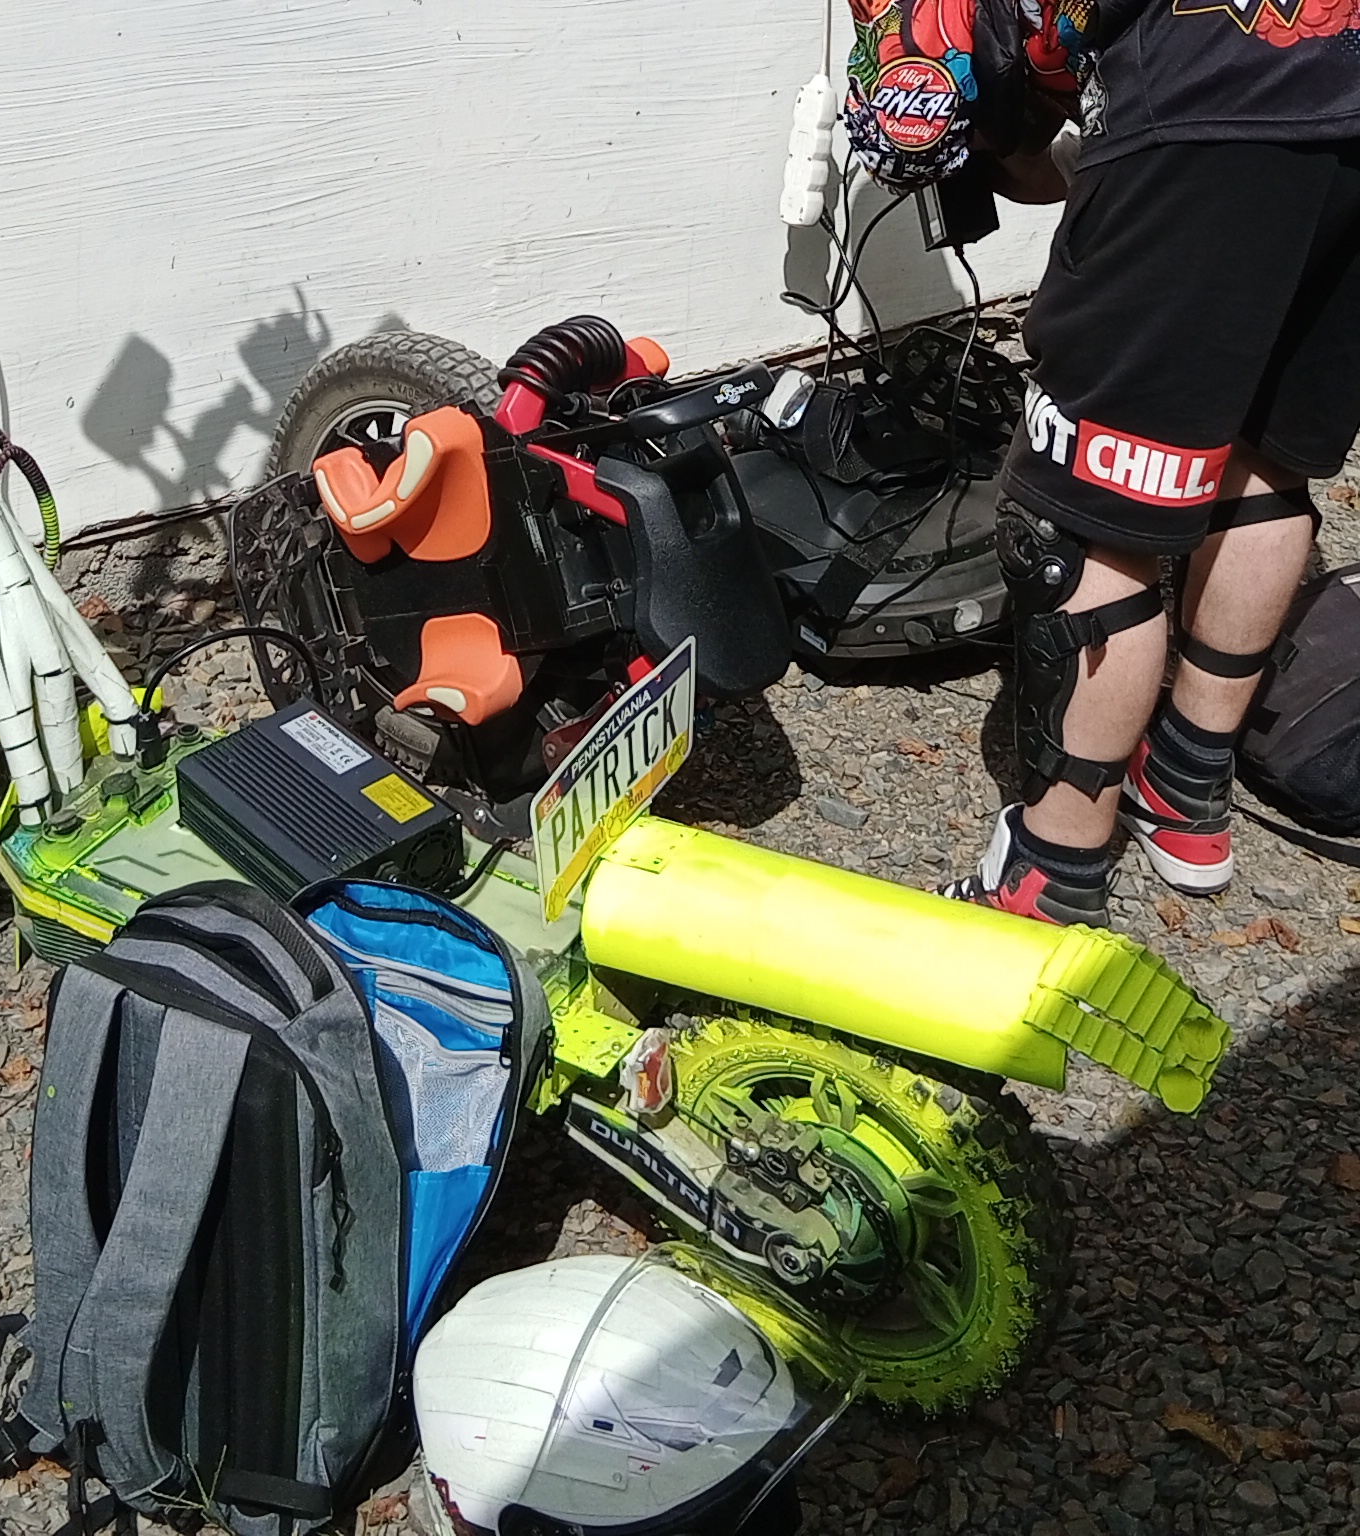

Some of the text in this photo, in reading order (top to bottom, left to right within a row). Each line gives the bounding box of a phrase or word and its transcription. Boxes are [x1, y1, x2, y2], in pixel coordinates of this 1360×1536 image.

[885, 120, 937, 140] Quality
[1019, 369, 1215, 499] UST CHILL.
[550, 684, 678, 876] PATRICK
[570, 688, 653, 780] PENNSYLVANIA
